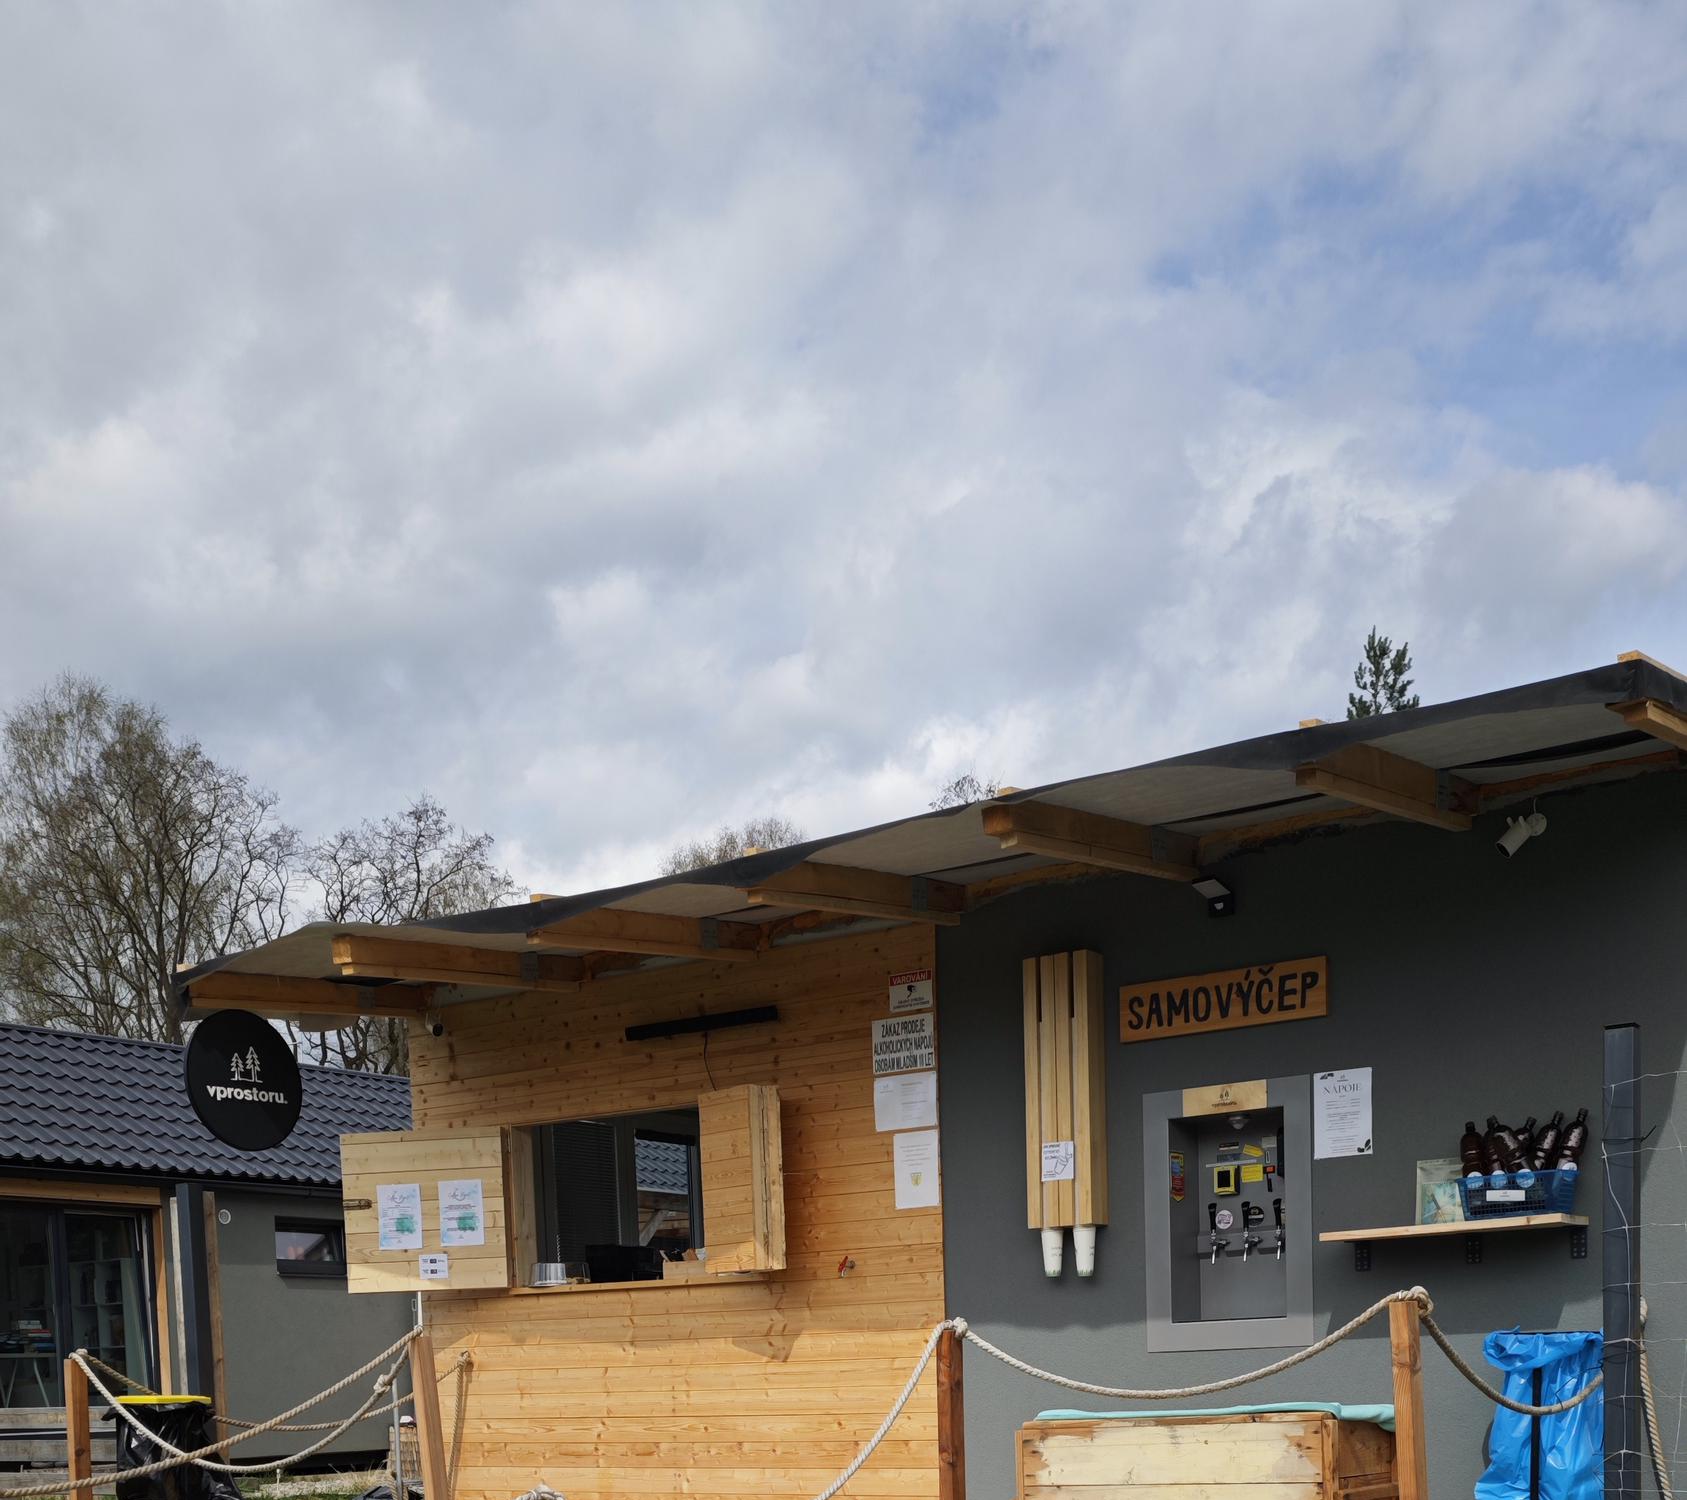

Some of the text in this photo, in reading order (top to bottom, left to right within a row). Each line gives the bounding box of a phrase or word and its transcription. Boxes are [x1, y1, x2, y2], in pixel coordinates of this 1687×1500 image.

[1128, 966, 1319, 1030] SAMOVÝČEP
[881, 1019, 925, 1038] ZÁKAZ PRODEJE
